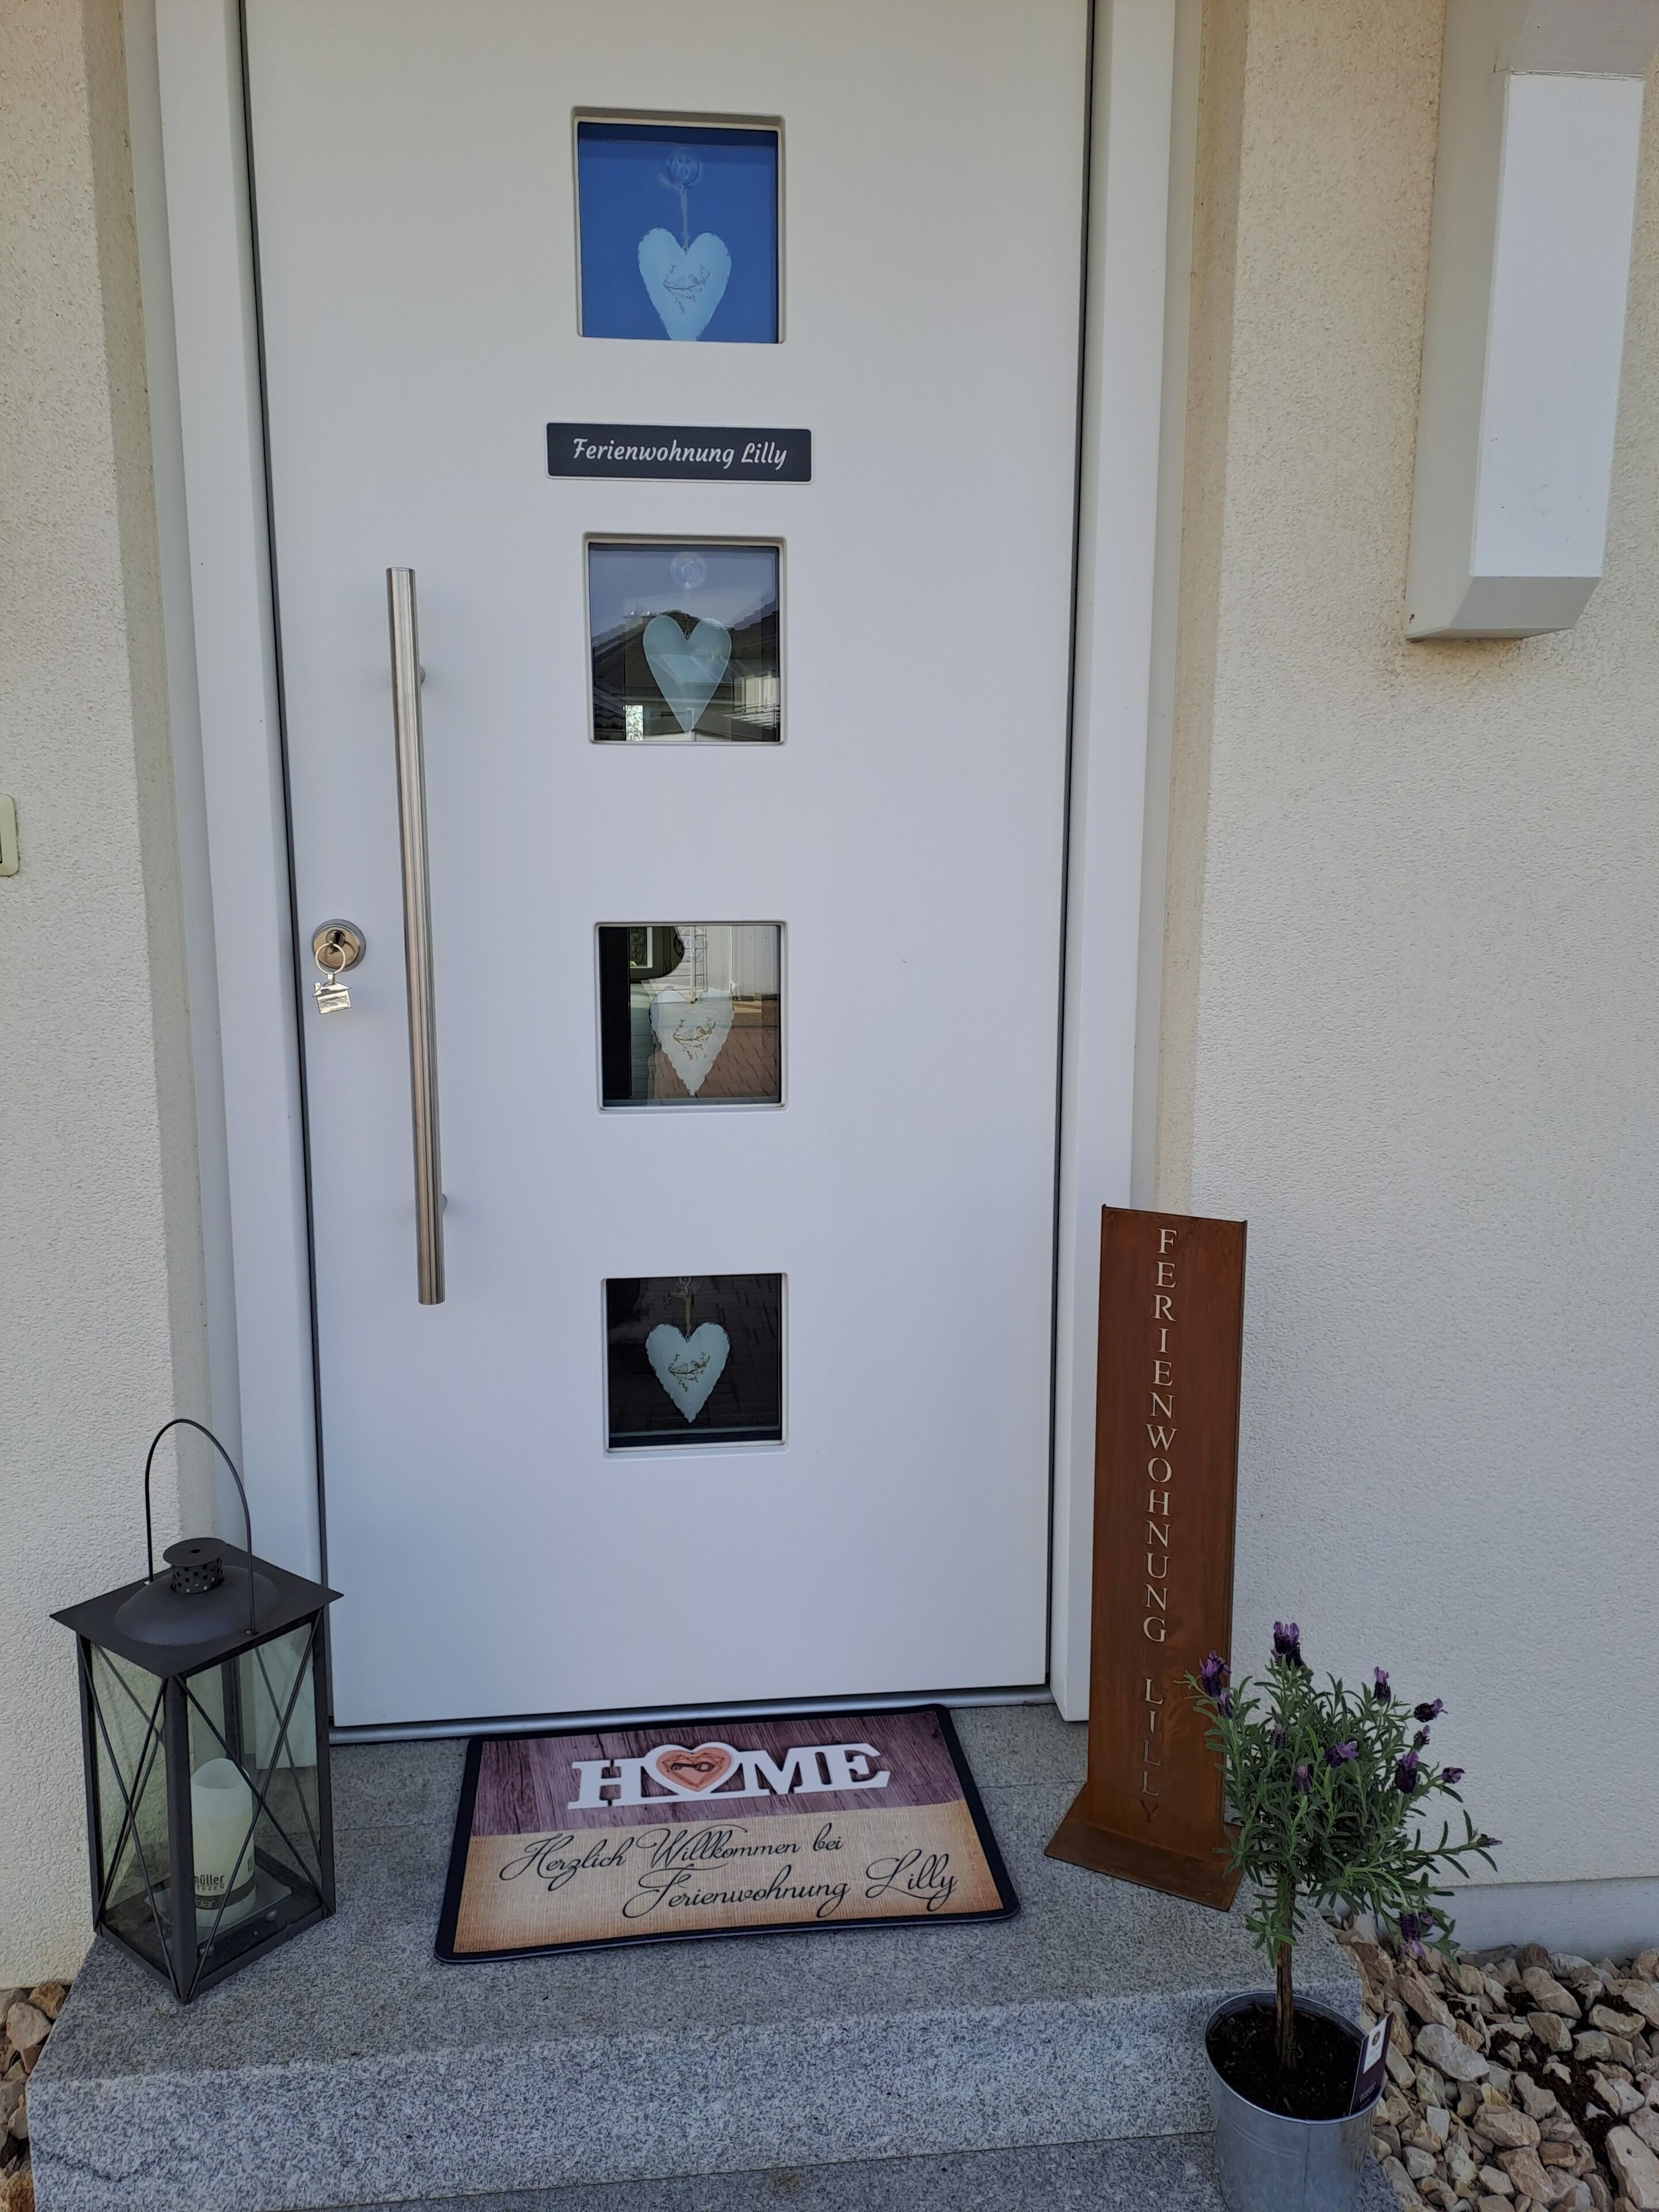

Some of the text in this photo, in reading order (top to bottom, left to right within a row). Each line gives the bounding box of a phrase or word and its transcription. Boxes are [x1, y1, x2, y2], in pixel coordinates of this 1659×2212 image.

[573, 438, 787, 471] Ferienwohnung Lilly
[1139, 1228, 1178, 1824] FERIENWOHNUNG LILLY
[567, 1741, 891, 1810] HOME
[499, 1822, 844, 1892] Herzlich Willkommen bei
[622, 1849, 959, 1919] Ferienwohnung Lilly
[195, 1898, 216, 1908] olar
